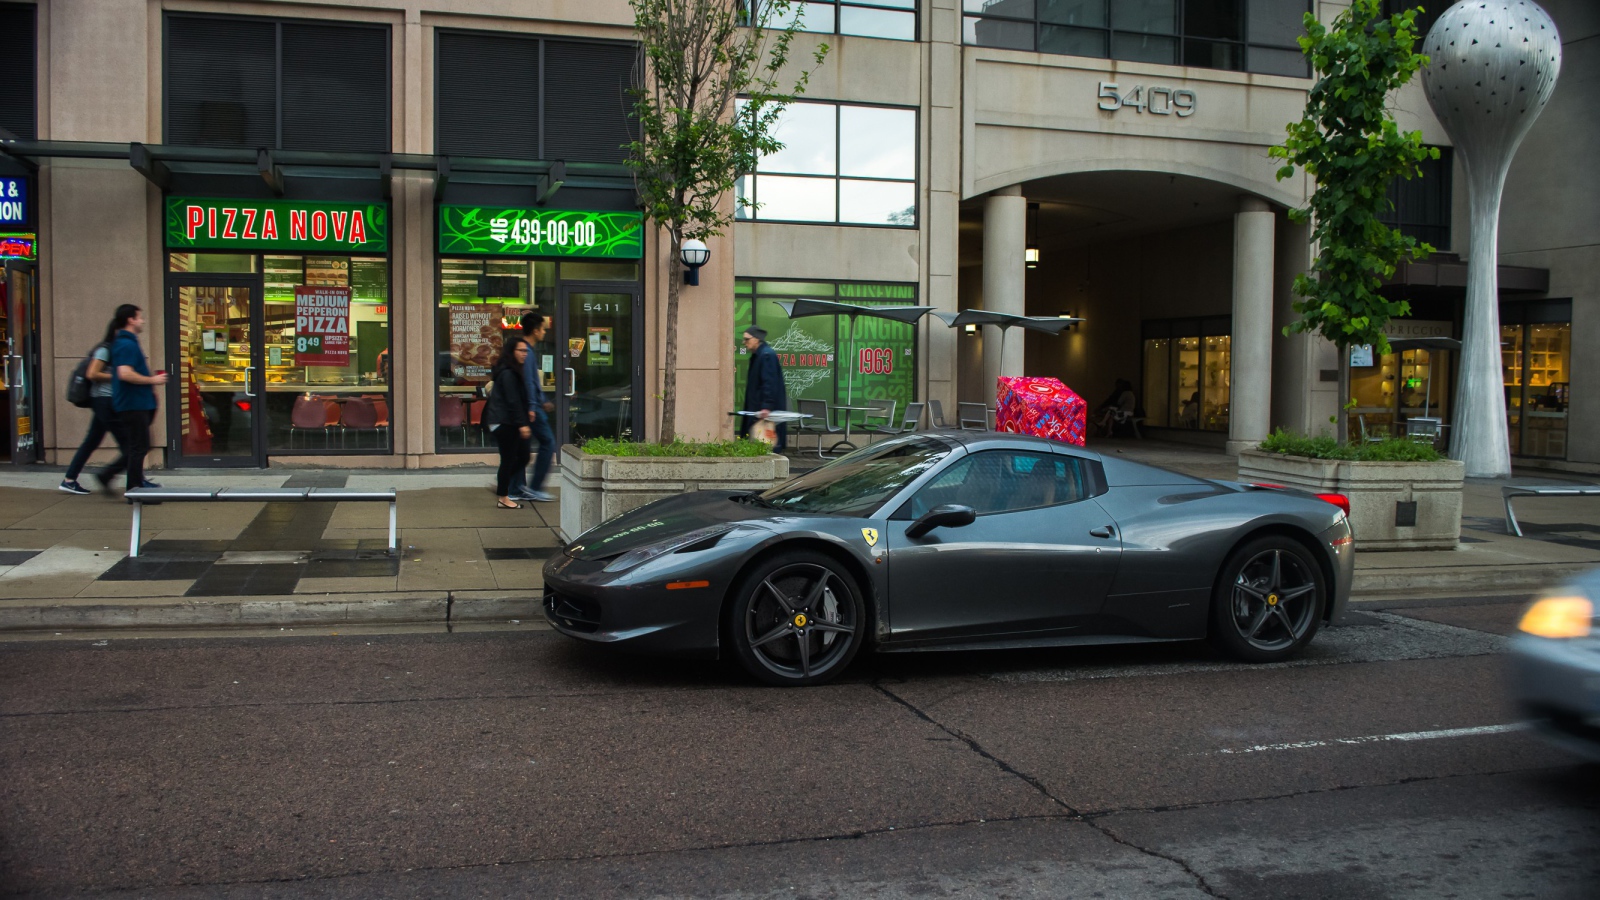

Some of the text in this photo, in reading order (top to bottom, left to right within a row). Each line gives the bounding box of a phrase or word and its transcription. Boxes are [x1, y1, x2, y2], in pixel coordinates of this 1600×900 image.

[1098, 81, 1196, 117] 5409
[8, 181, 18, 197] &
[187, 206, 366, 243] PIZZA NOVA
[490, 218, 595, 246] 416 439-00-00
[297, 295, 348, 307] MEDIUM
[584, 303, 618, 311] 5411
[297, 307, 348, 316] PEPPERONI
[297, 316, 348, 333] PIZZA
[1380, 325, 1442, 335] APRICCIO
[776, 353, 828, 367] ZZA NOVA
[859, 347, 893, 374] 1963
